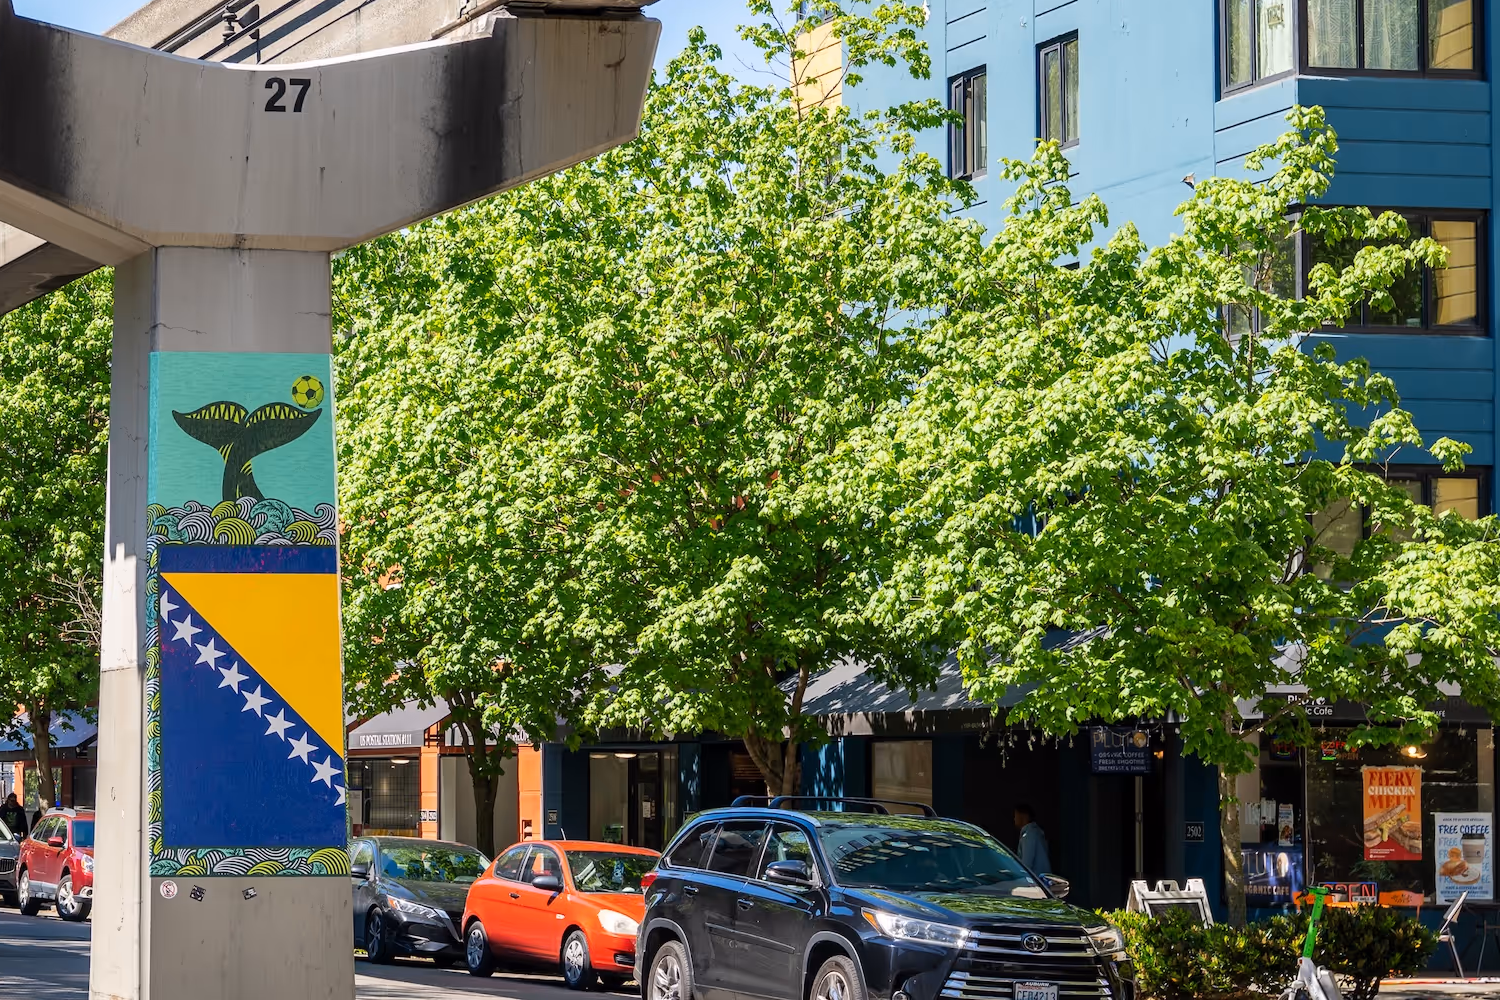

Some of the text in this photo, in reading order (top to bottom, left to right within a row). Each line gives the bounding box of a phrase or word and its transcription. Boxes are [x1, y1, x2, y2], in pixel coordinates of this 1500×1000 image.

[264, 78, 311, 112] 27
[360, 733, 412, 746] US POSTAL STATION #111
[1368, 771, 1415, 786] FIERY
[1367, 785, 1416, 796] CHICKEN
[1368, 795, 1415, 812] MELT
[1438, 824, 1490, 835] FREE COFFEE
